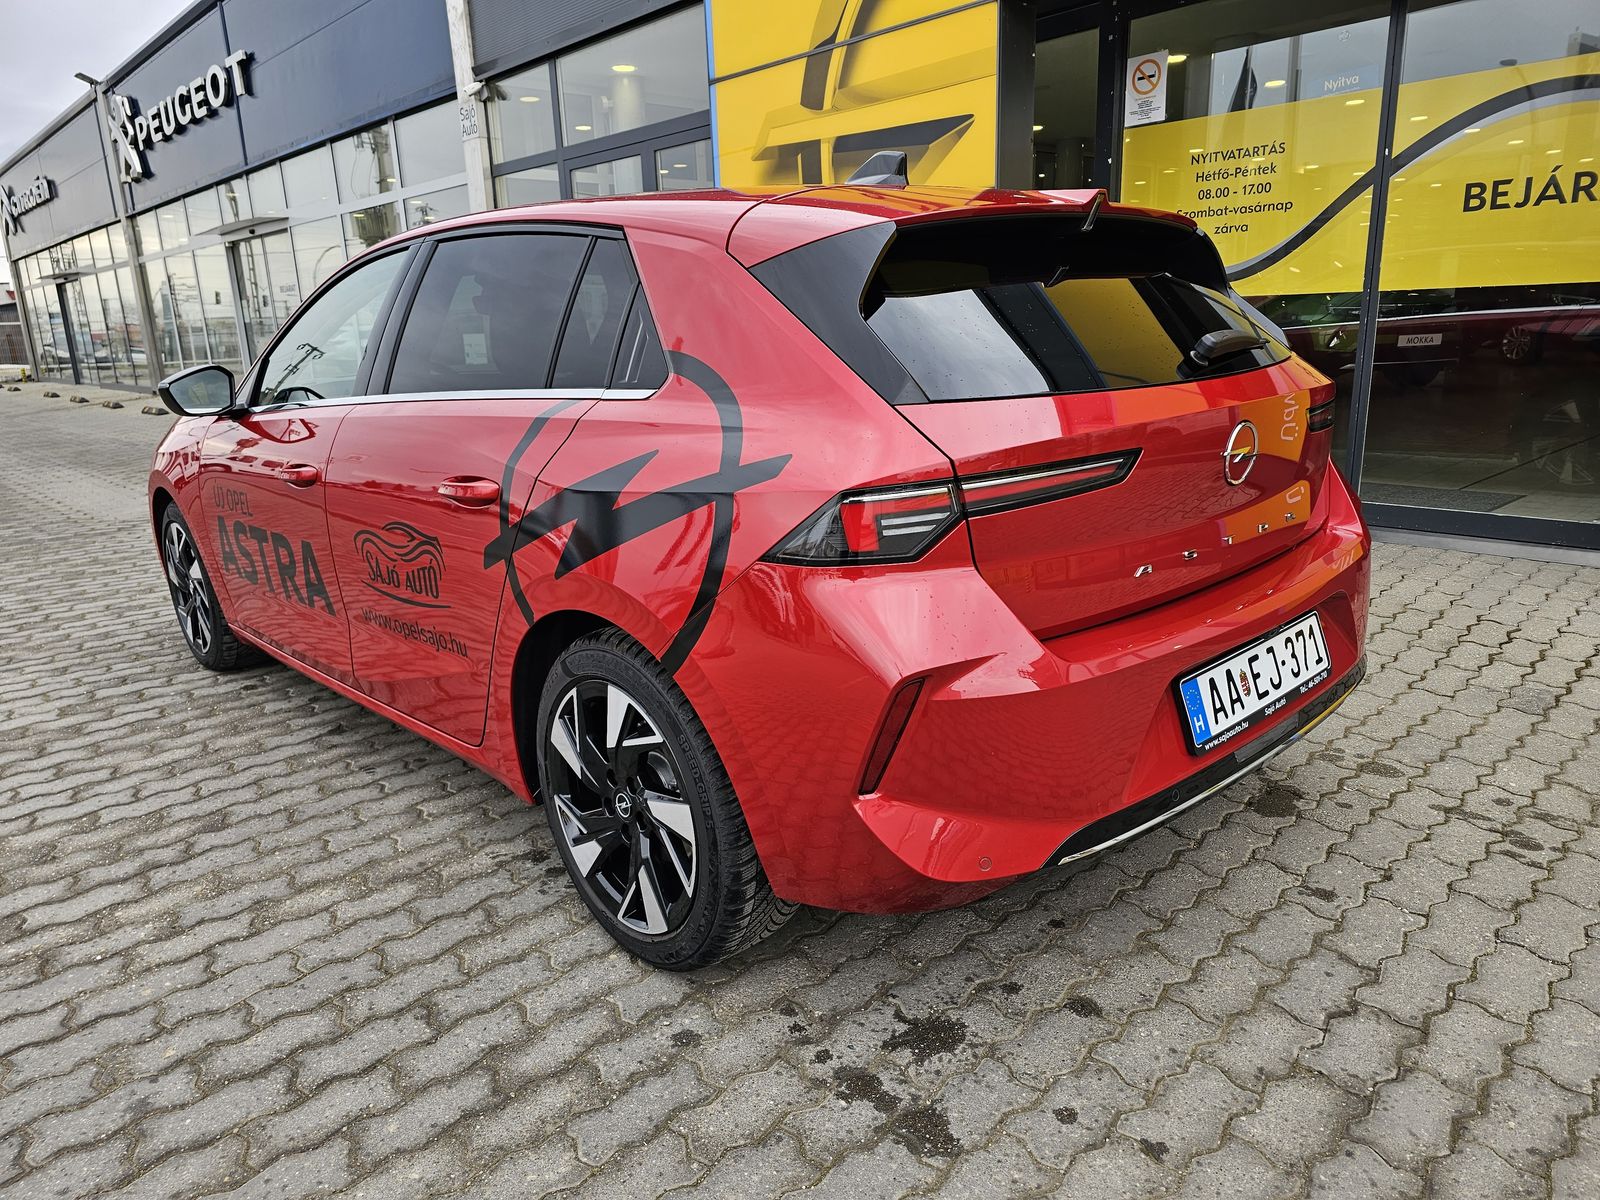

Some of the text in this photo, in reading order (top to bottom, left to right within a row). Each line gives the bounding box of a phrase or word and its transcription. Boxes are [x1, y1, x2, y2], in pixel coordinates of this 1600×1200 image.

[1324, 75, 1360, 92] Nyitva
[134, 49, 248, 151] PEUGEOT
[1190, 140, 1286, 165] NYITVATARTÁS
[1195, 162, 1277, 183] Hétfő-Péntek
[1198, 187, 1230, 200] 08.00
[1242, 182, 1272, 195] 17.00
[1214, 223, 1249, 235] zárva
[1405, 335, 1434, 345] MOKKA
[226, 489, 254, 518] OPEL
[216, 515, 337, 617] ASTRA
[365, 550, 440, 599] SAJÓ AUTÓ
[361, 607, 469, 658] www.opelsajo.hu
[1208, 624, 1324, 725] AA EJ-371
[1193, 714, 1205, 733] H
[677, 735, 712, 816] SPEED-GRIP
